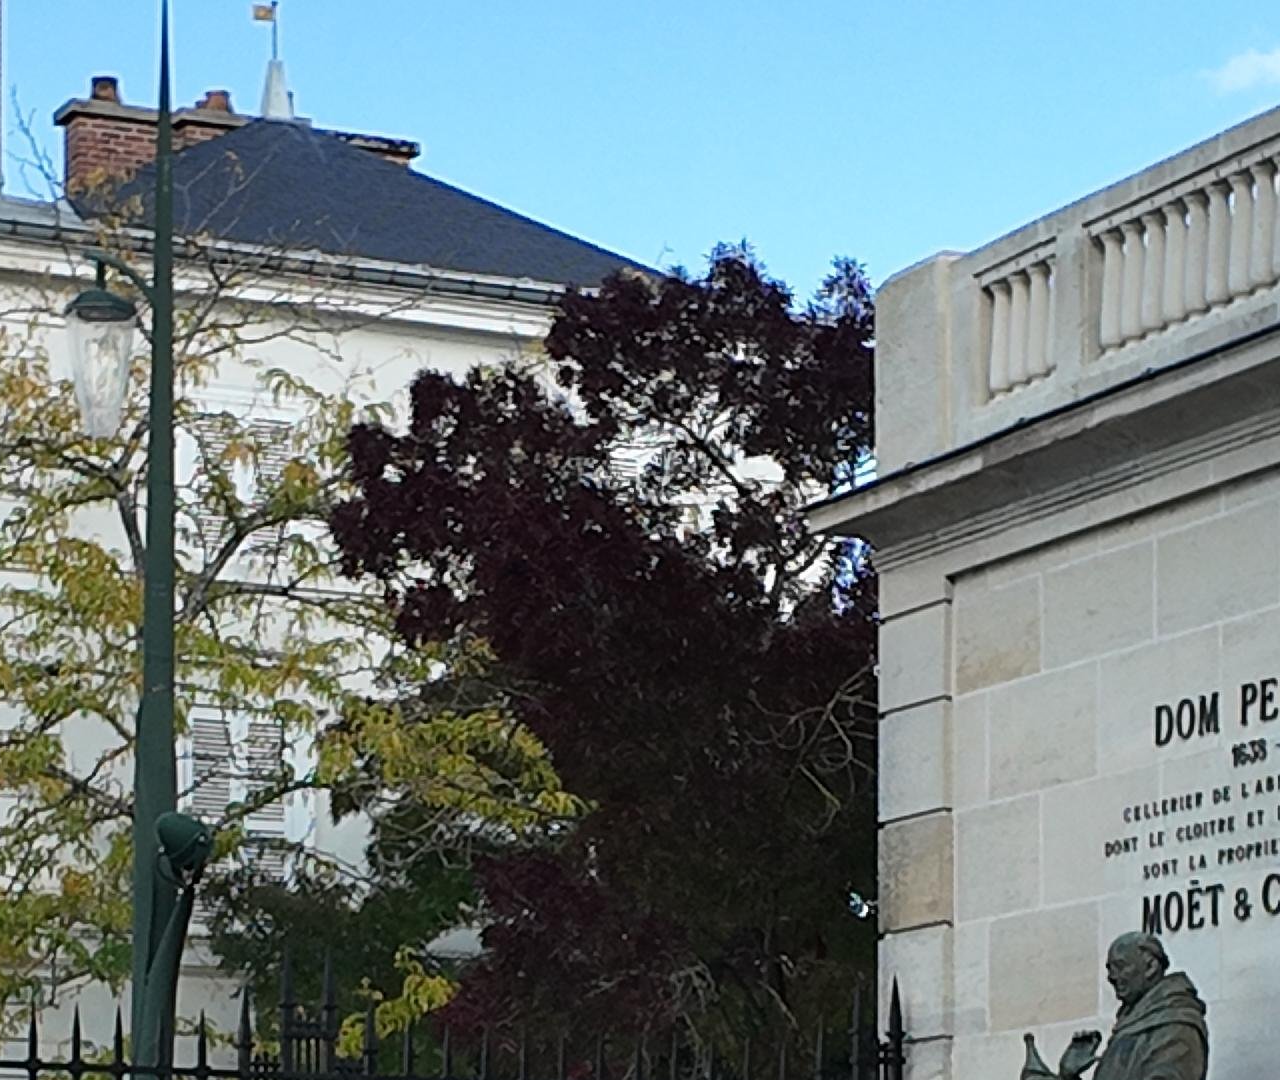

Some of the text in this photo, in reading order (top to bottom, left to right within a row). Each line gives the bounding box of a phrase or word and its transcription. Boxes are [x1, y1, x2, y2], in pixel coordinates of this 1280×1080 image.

[1154, 690, 1221, 749] DOM
[1122, 791, 1203, 824] CELLERIER
[1212, 785, 1231, 806] DE
[1104, 836, 1139, 859] DONT
[1148, 830, 1165, 849] LE
[1246, 809, 1265, 830] ET
[1142, 858, 1179, 881] SONT
[1188, 853, 1208, 873] LA
[1142, 879, 1226, 932] MOËT
[1233, 887, 1254, 924] &
